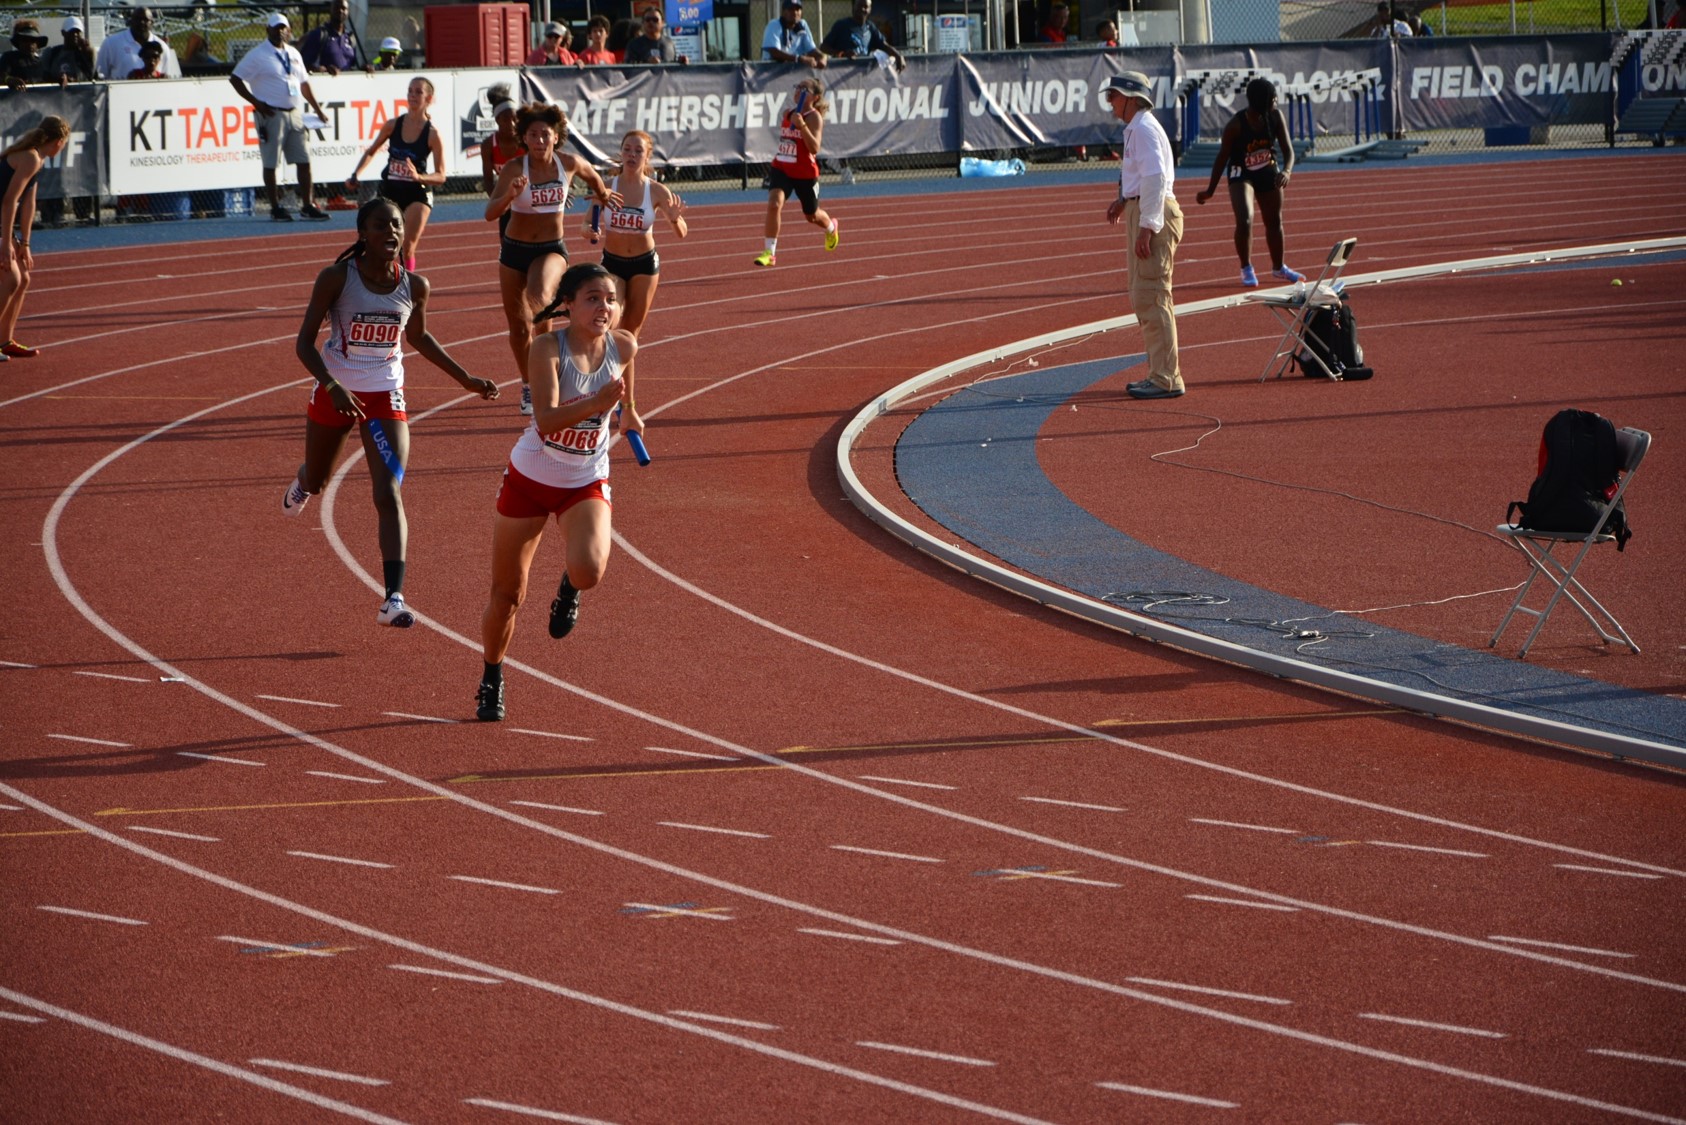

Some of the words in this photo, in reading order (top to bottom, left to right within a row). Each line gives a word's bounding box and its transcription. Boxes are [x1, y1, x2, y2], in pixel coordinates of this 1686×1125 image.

[556, 98, 627, 136] ATF
[635, 92, 787, 133] HERSHEY
[822, 85, 949, 124] ATIONAL
[969, 79, 1089, 117] JUNIOR
[1270, 70, 1354, 104] RACK
[1410, 66, 1505, 99] FIELD
[130, 109, 172, 152] KT
[178, 105, 260, 149] TAPE
[350, 99, 409, 140] TA
[130, 154, 184, 168] KINESIOLOGY
[186, 151, 241, 164] THERAPEUTIC
[243, 150, 262, 161] TAPE
[309, 146, 356, 157] INESIOLOGY
[531, 187, 564, 205] 5628
[610, 211, 643, 230] 5646
[350, 323, 399, 343] 6090
[373, 430, 393, 464] USA
